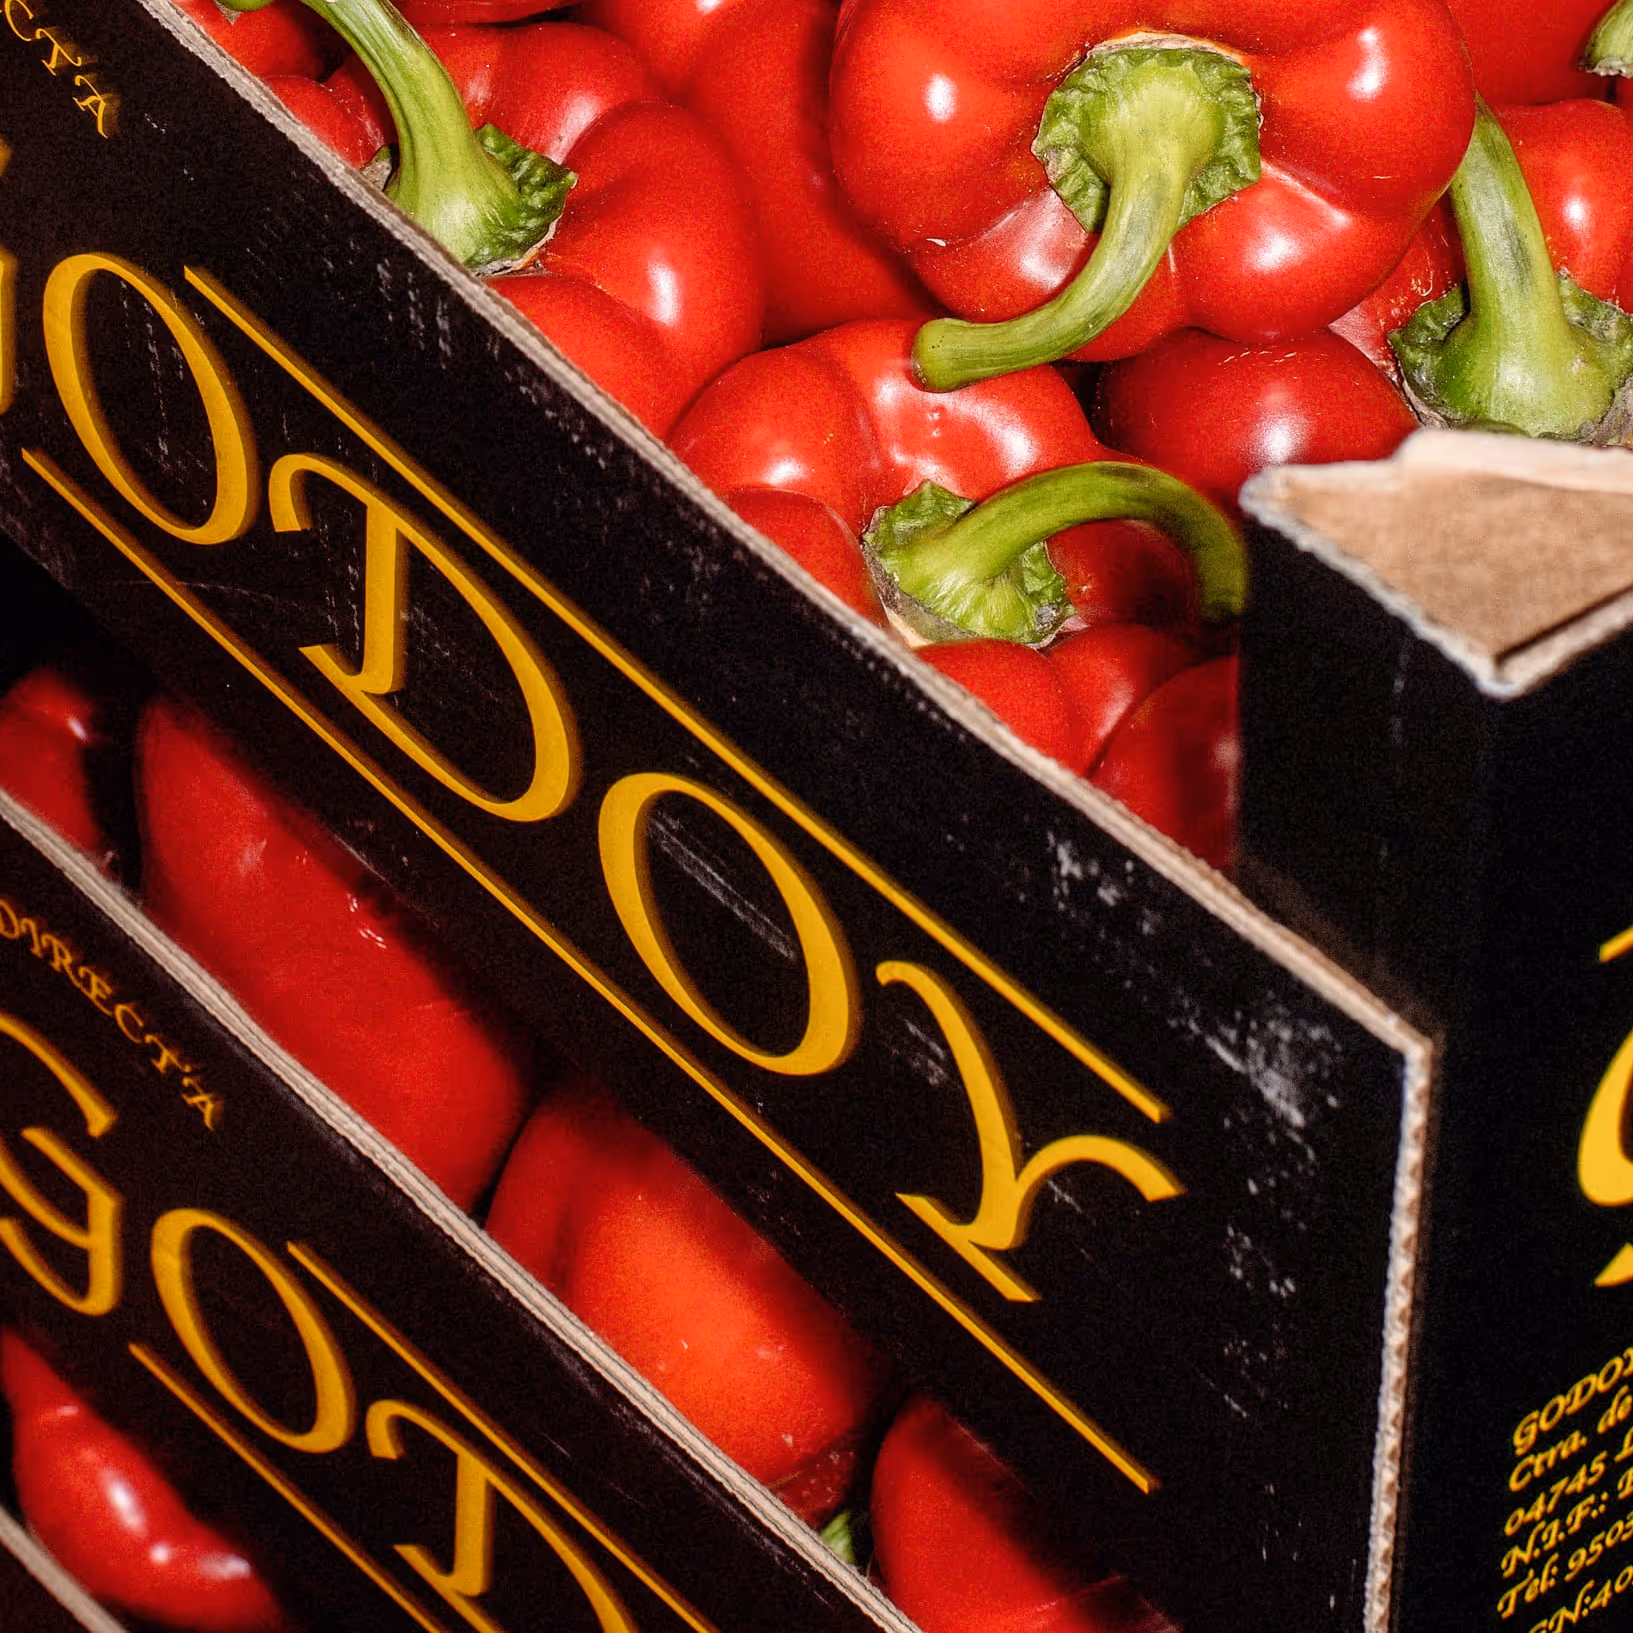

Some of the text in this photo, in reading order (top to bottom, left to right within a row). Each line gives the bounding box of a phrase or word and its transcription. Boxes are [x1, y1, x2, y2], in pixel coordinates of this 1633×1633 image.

[1509, 1430, 1587, 1492] Ctra.
[1597, 1385, 1632, 1434] de
[1504, 1451, 1607, 1537] 04745
